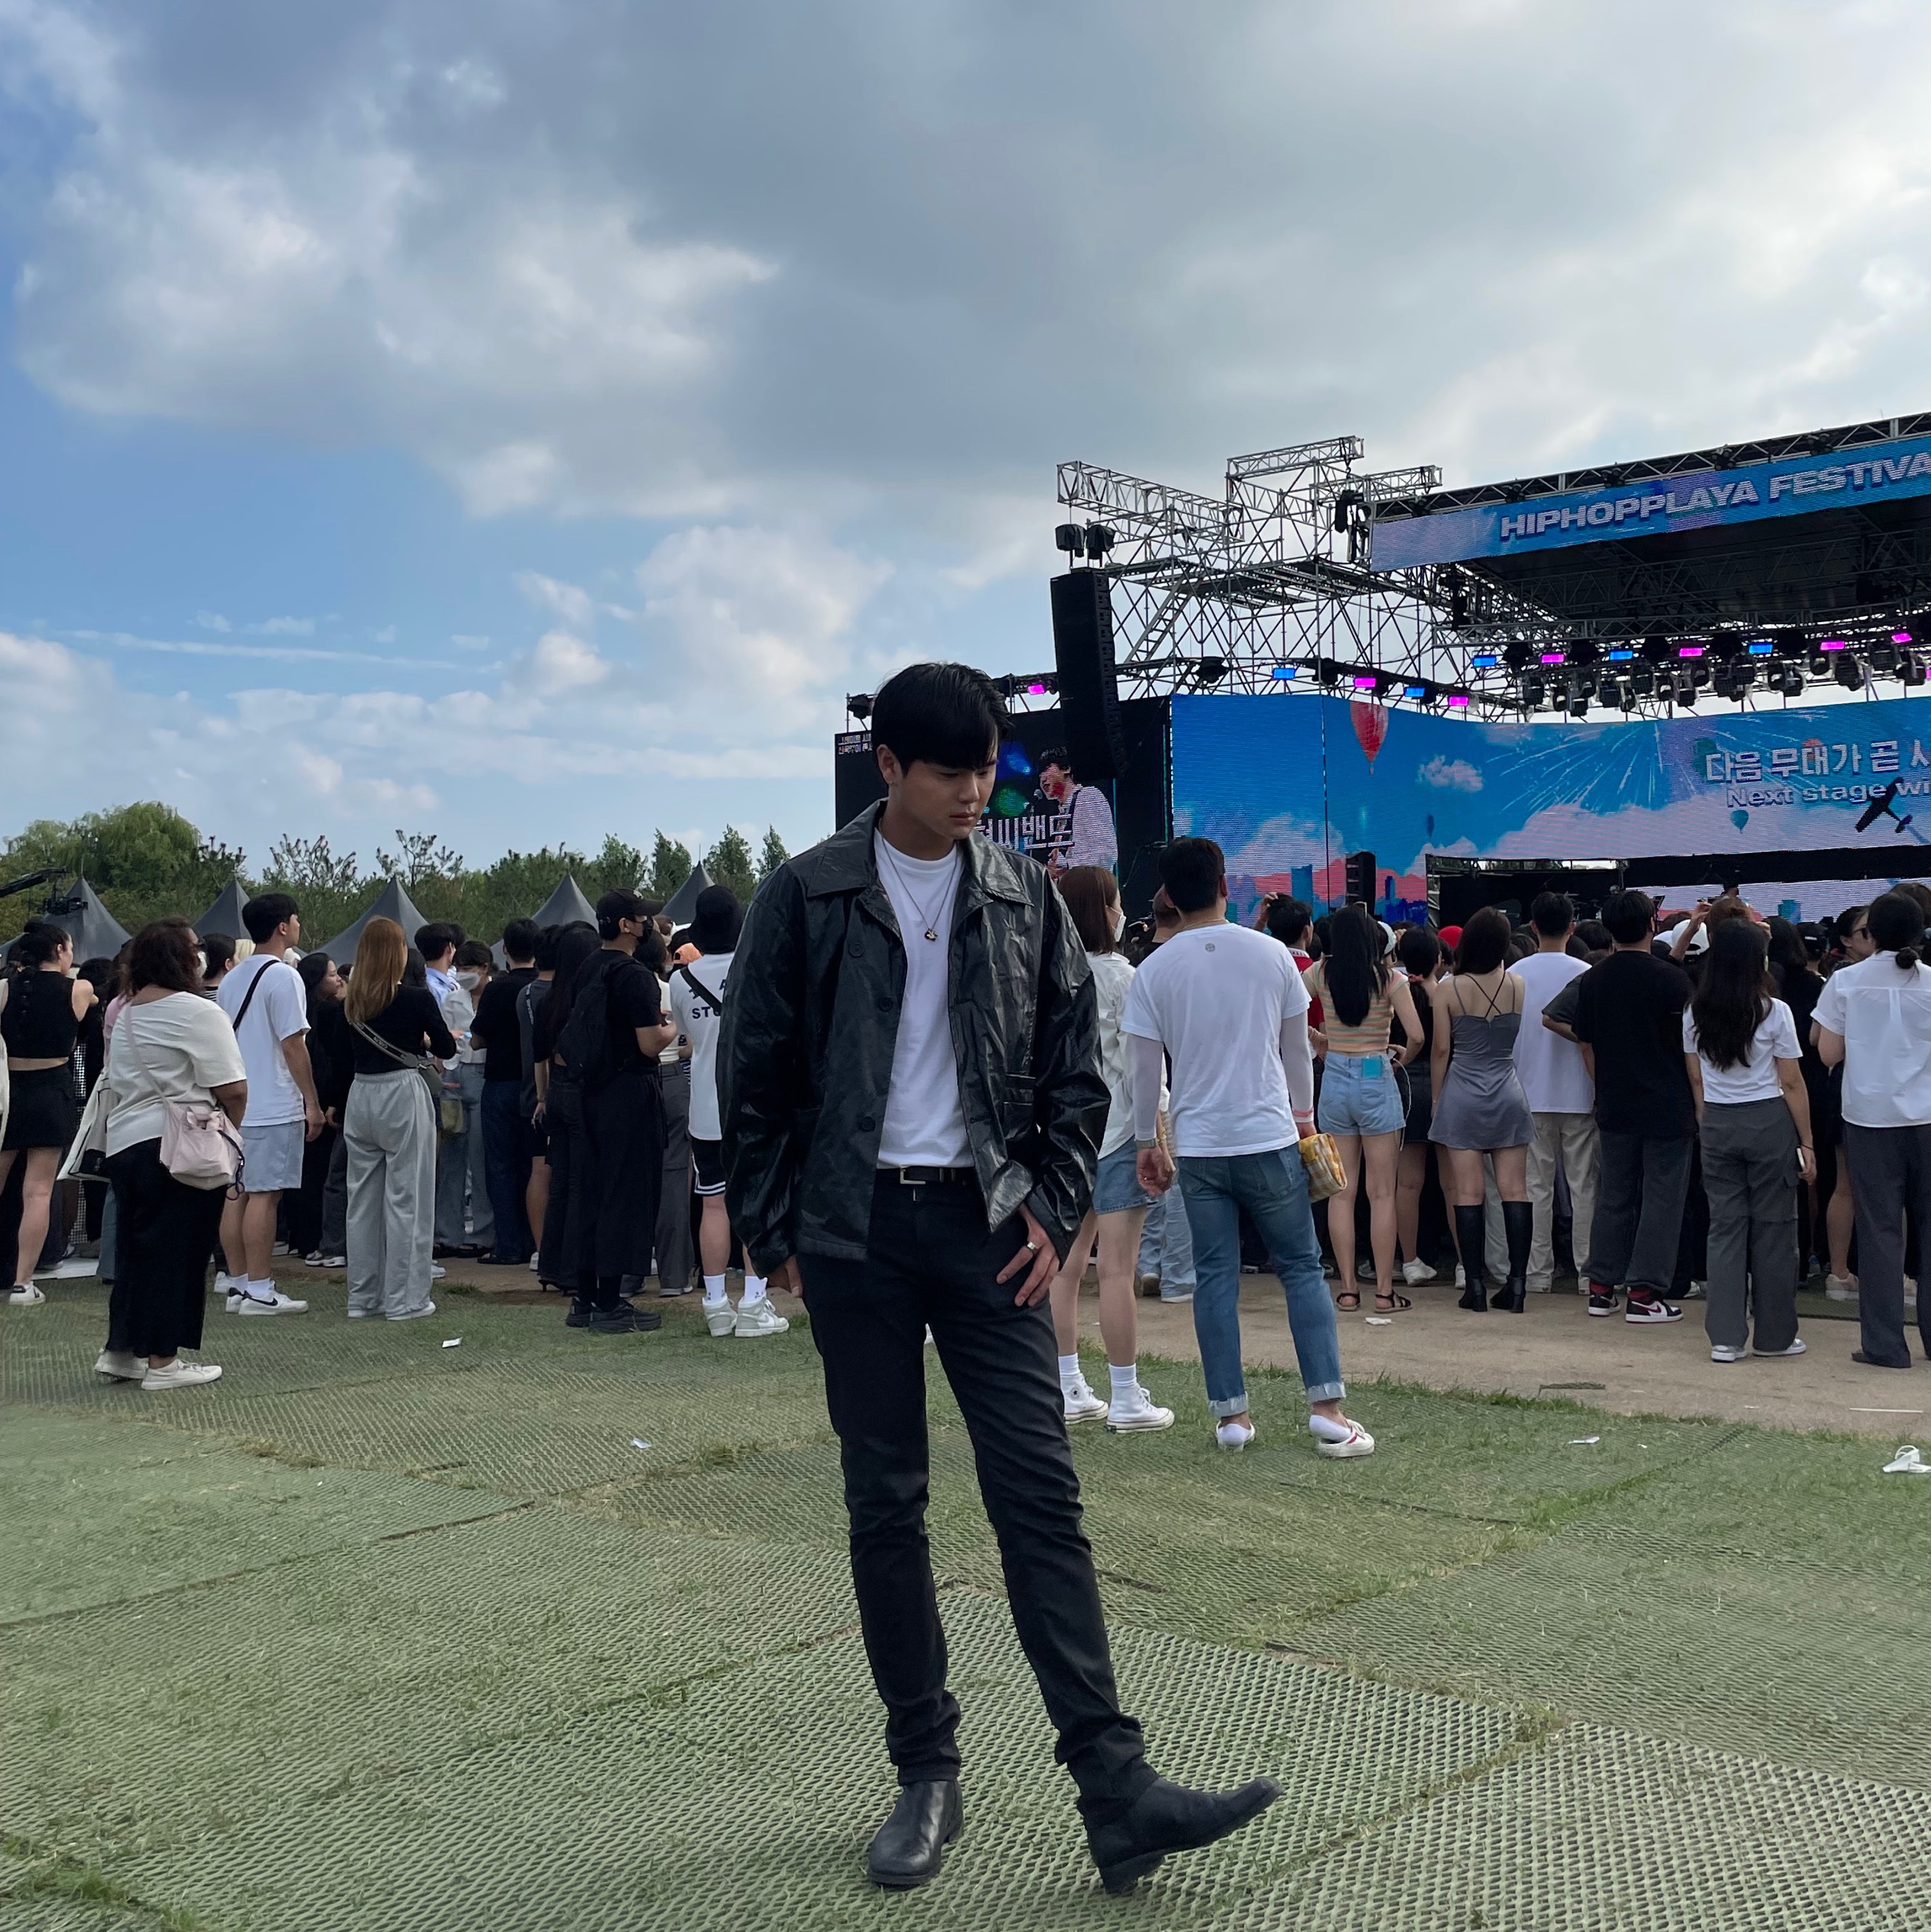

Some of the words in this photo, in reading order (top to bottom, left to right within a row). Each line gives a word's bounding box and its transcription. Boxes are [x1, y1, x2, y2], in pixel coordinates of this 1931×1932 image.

[1500, 480, 1760, 537] HIPHOPPLAYA
[1706, 751, 1762, 782] 다음
[1770, 743, 1861, 777] 무대가
[1870, 740, 1900, 772] 곧
[1727, 786, 1794, 807] Next
[1802, 784, 1887, 803] stage
